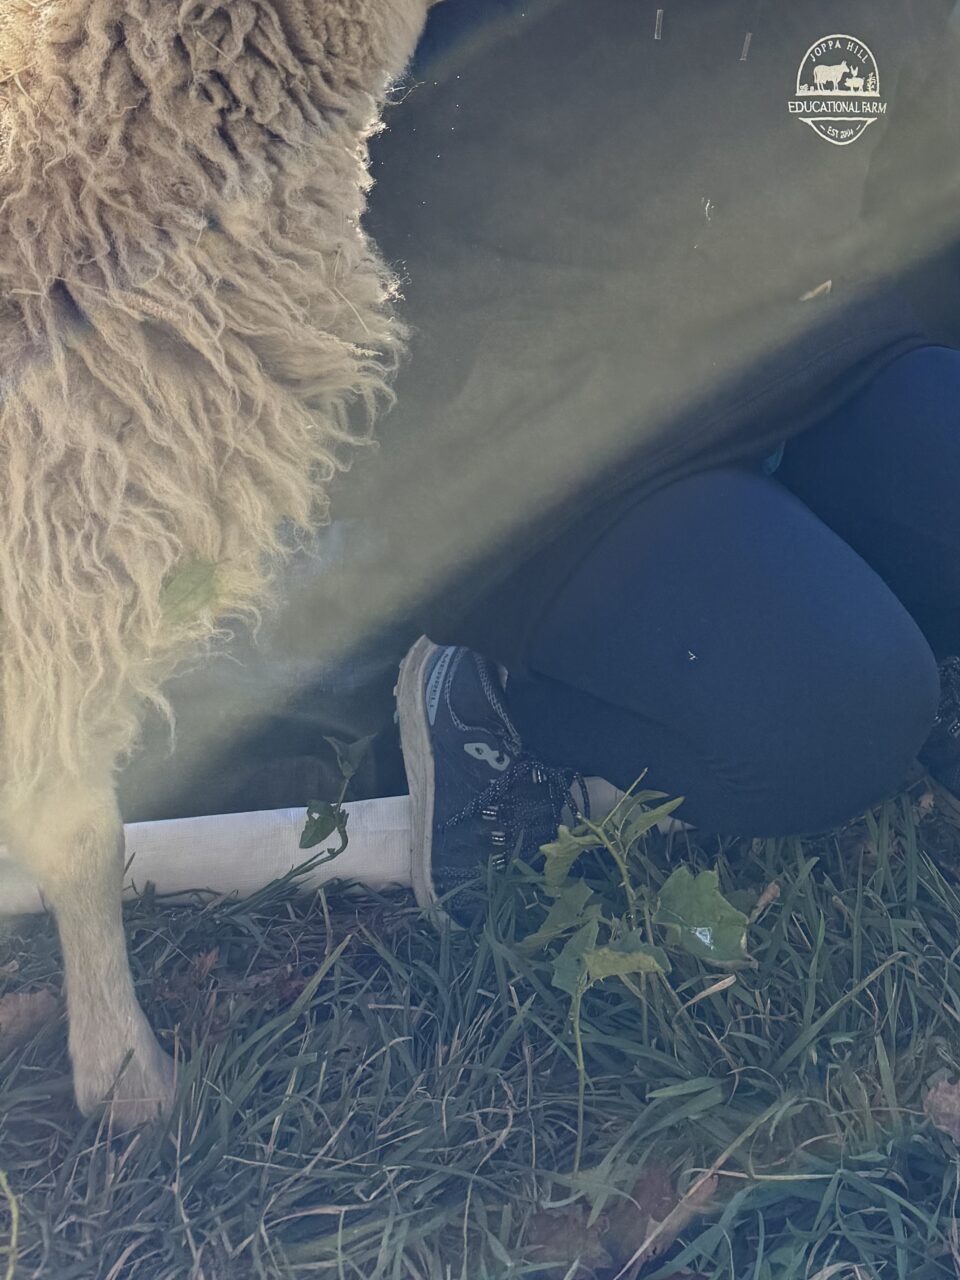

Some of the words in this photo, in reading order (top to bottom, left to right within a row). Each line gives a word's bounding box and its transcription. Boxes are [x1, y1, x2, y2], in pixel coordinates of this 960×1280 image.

[810, 40, 841, 62] JOPPA
[846, 41, 868, 63] HILL
[788, 101, 860, 113] EDUCATIONAL
[861, 102, 887, 114] FARM
[827, 126, 839, 138] EST
